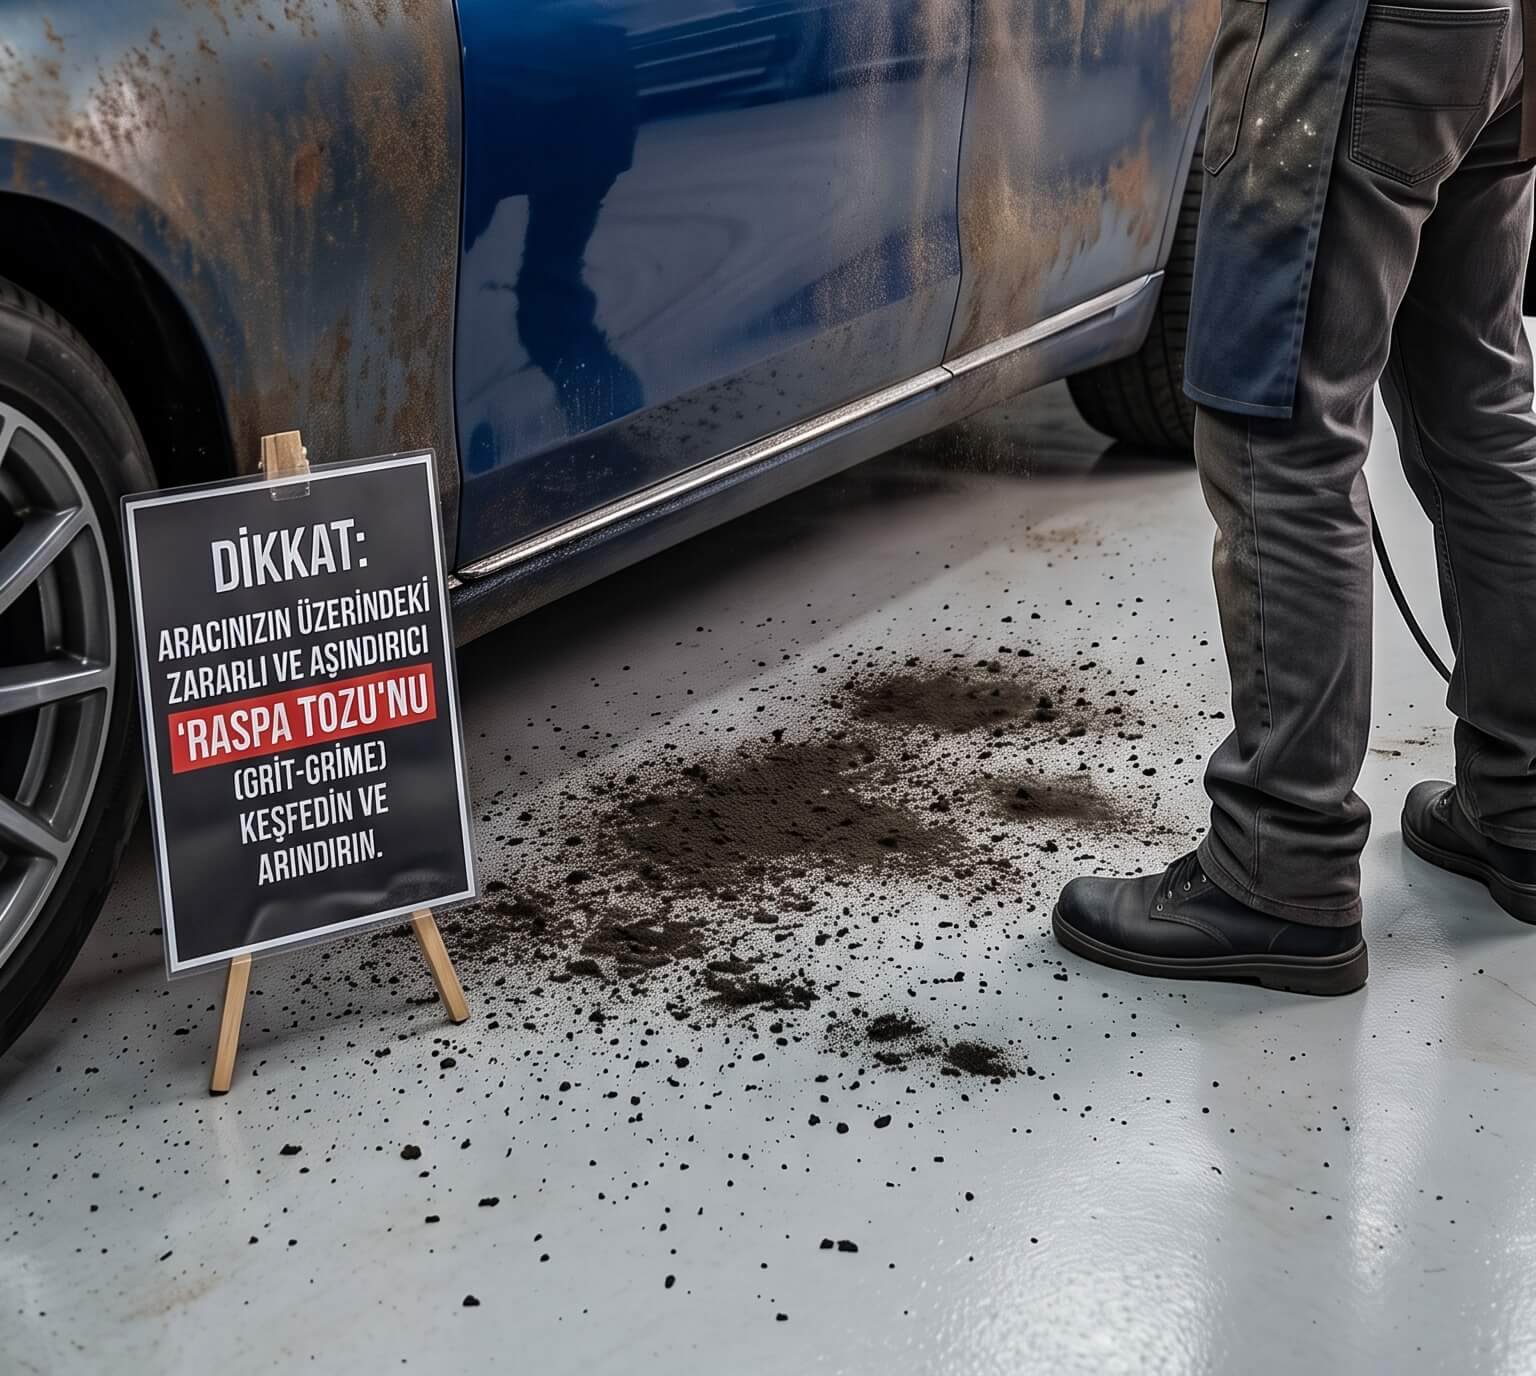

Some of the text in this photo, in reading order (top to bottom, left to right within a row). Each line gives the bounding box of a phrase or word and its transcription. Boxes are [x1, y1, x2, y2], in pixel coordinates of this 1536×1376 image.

[210, 518, 368, 593] DİKKAT:
[158, 575, 431, 662] ARACINIZIN ÜZERİNDEKİ
[166, 624, 430, 704] ZARARLI VE AŞINDIRICI
[297, 673, 429, 737] TOZU'NU
[233, 740, 387, 801] (GRİT-GRİME)
[239, 782, 389, 843] KEŞFEDİN VE
[257, 828, 383, 886] ARINDIRIN.
